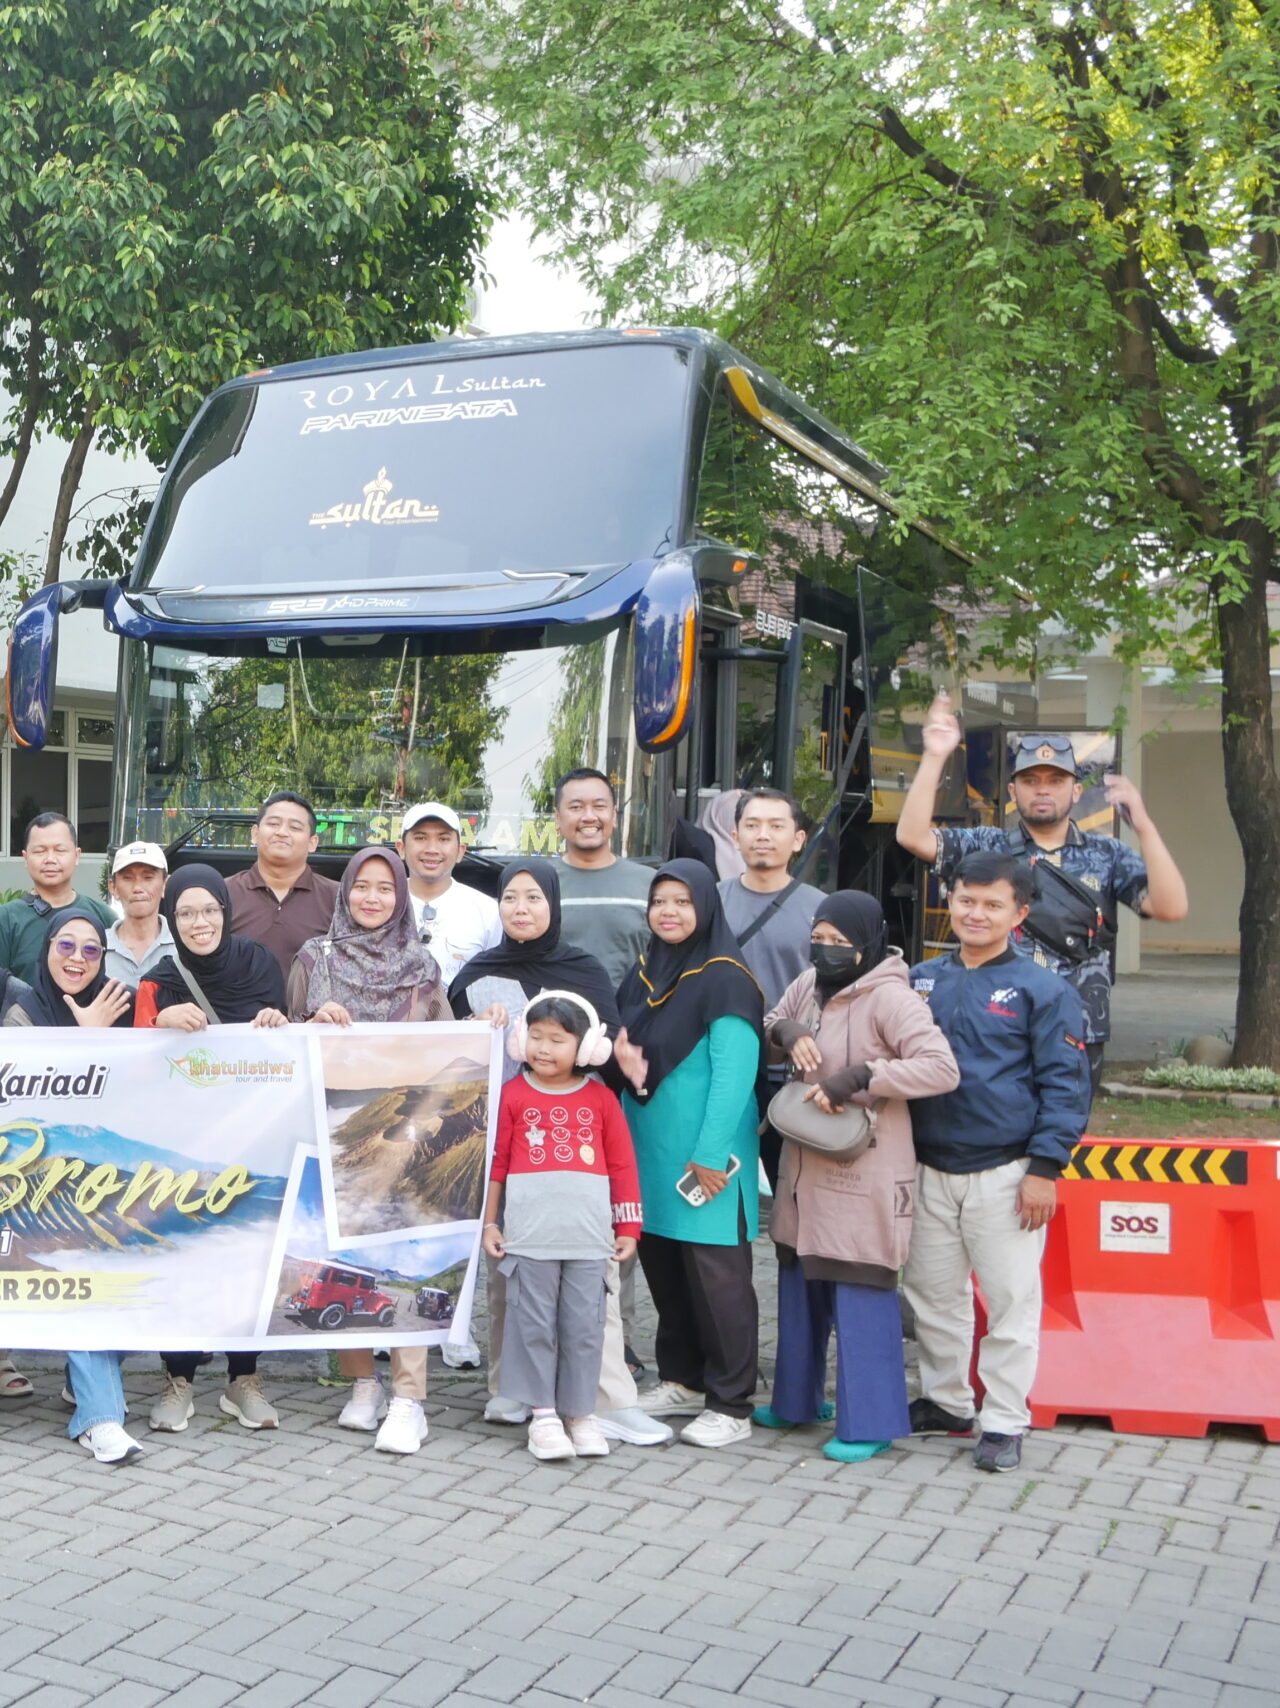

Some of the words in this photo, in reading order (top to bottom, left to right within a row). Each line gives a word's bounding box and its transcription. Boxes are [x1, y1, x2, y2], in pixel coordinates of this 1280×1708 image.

[299, 374, 454, 409] ROYAL
[456, 377, 546, 393] Sultan
[299, 399, 518, 435] PARIWISATA
[364, 597, 410, 607] PRIME
[253, 1074, 269, 1083] and
[1110, 1214, 1159, 1234] SOS
[0, 1231, 15, 1256] 1
[26, 1277, 92, 1300] 2025
